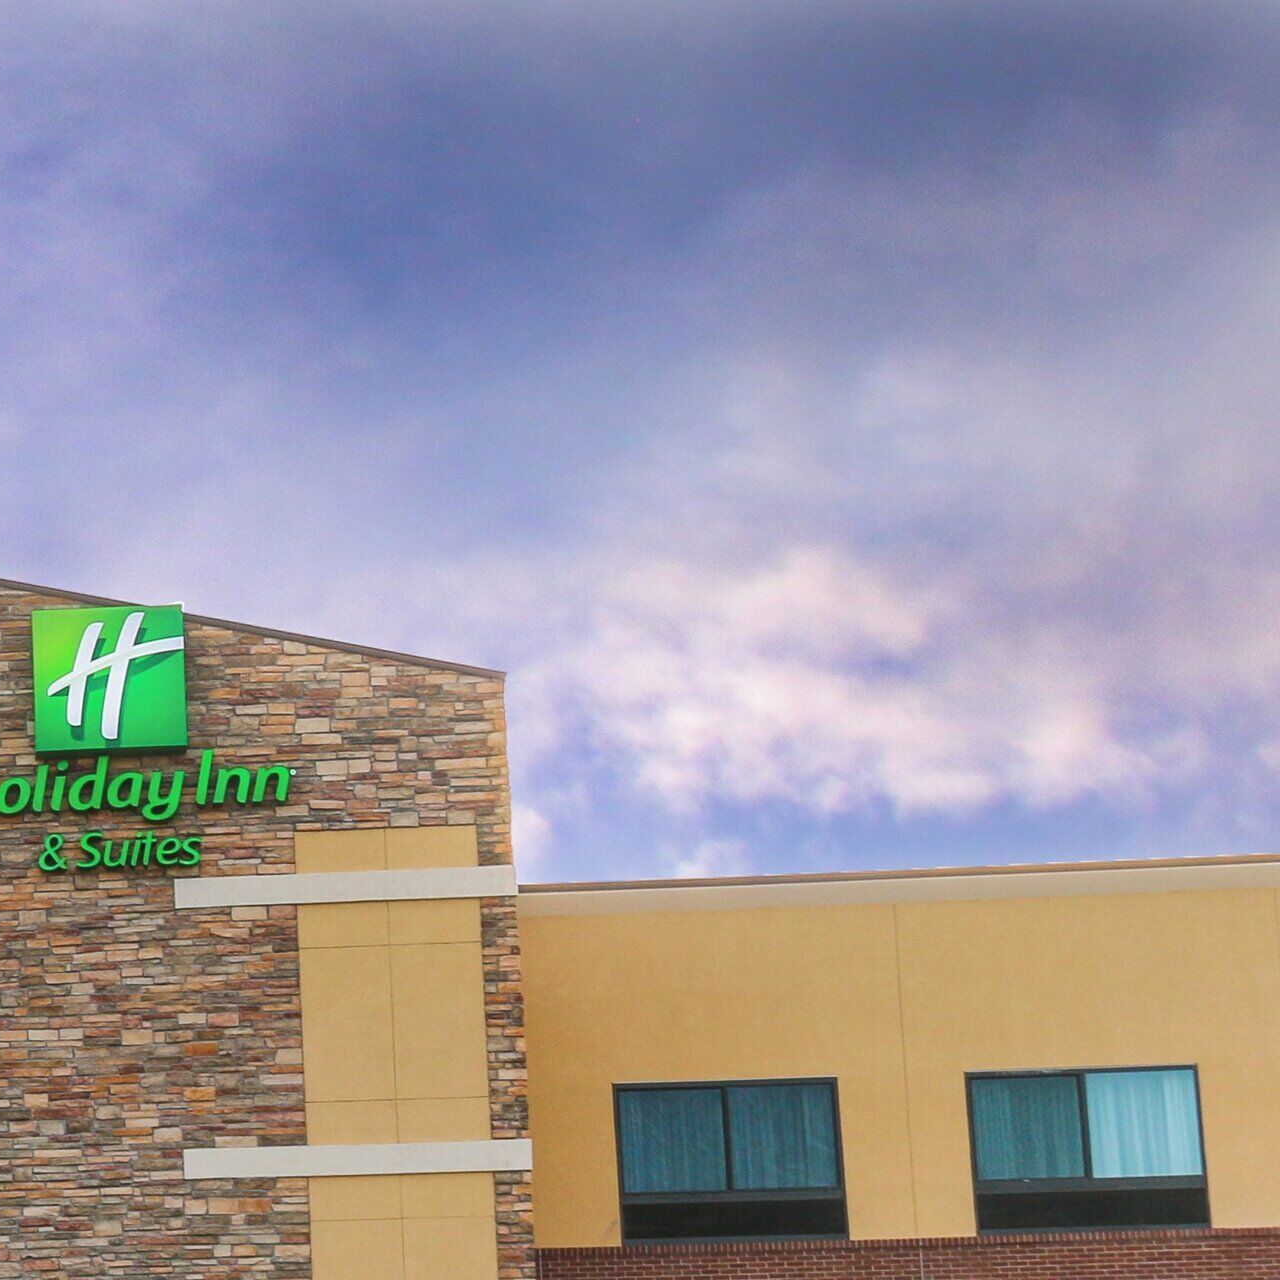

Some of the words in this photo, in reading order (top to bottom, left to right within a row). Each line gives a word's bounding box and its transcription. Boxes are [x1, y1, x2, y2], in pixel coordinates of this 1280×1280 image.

[46, 611, 185, 740] H
[195, 749, 291, 805] Inn
[38, 833, 68, 871] &
[76, 830, 203, 868] Suites
